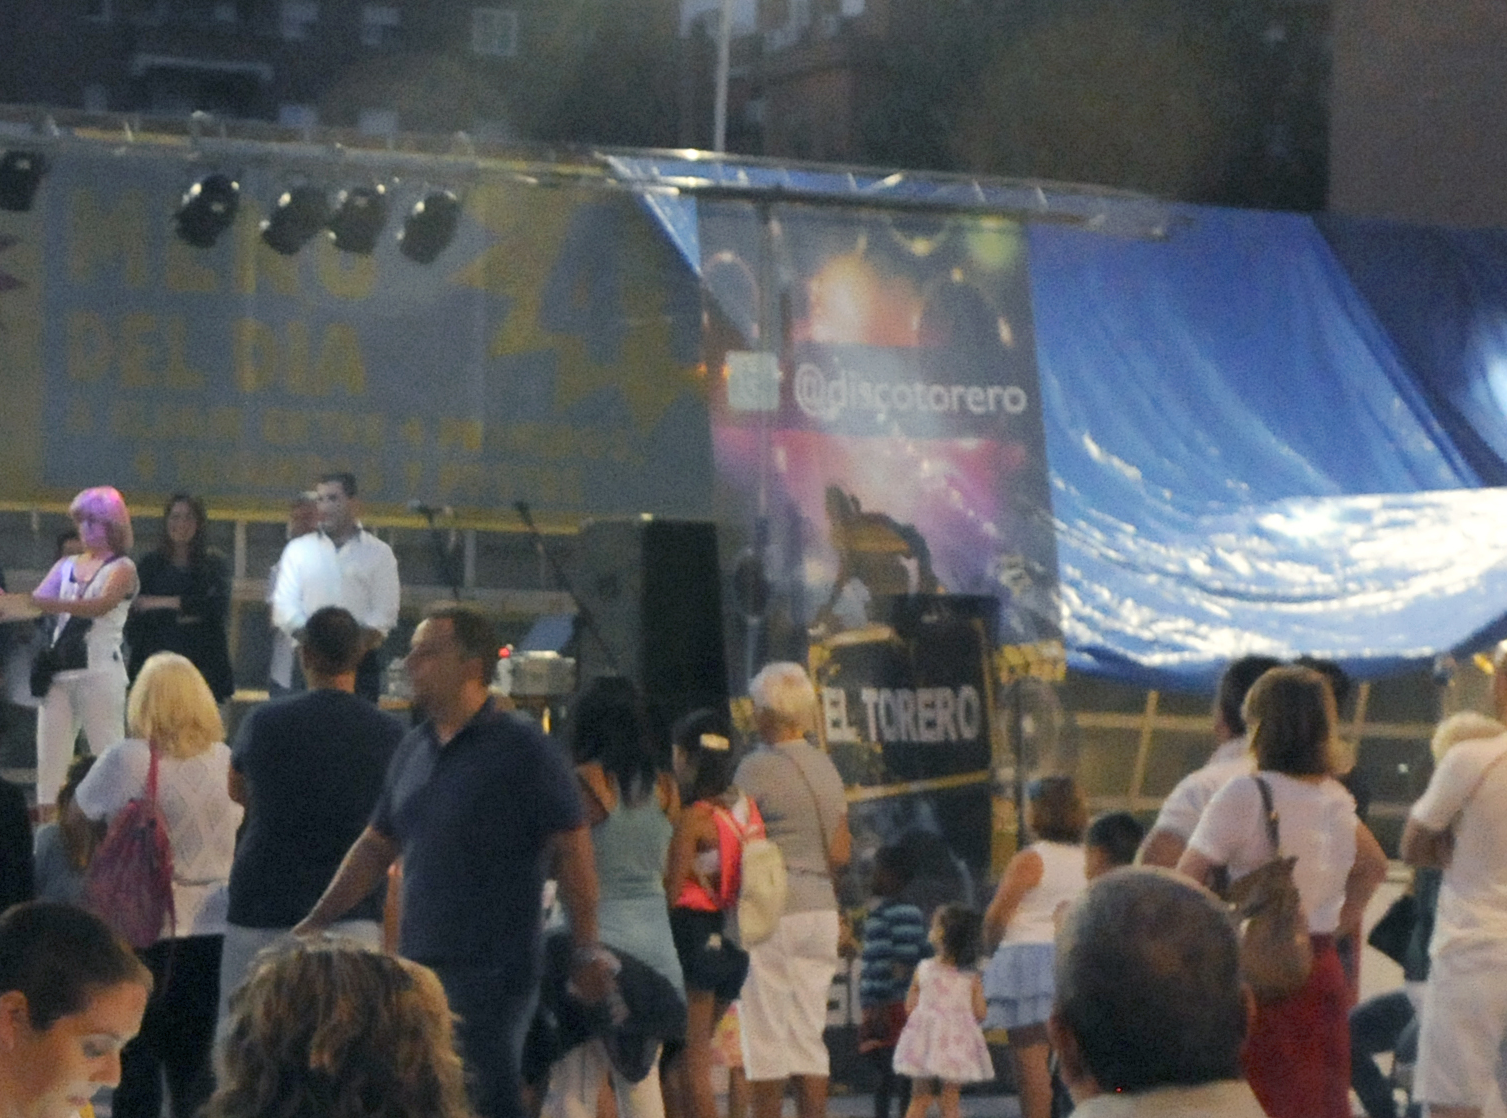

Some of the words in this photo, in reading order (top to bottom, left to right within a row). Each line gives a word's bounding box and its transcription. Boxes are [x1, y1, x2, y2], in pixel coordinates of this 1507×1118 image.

[64, 309, 208, 389] DEL
[794, 363, 1028, 420] @discotorero
[822, 687, 859, 741] EL
[861, 685, 981, 742] TORERO
